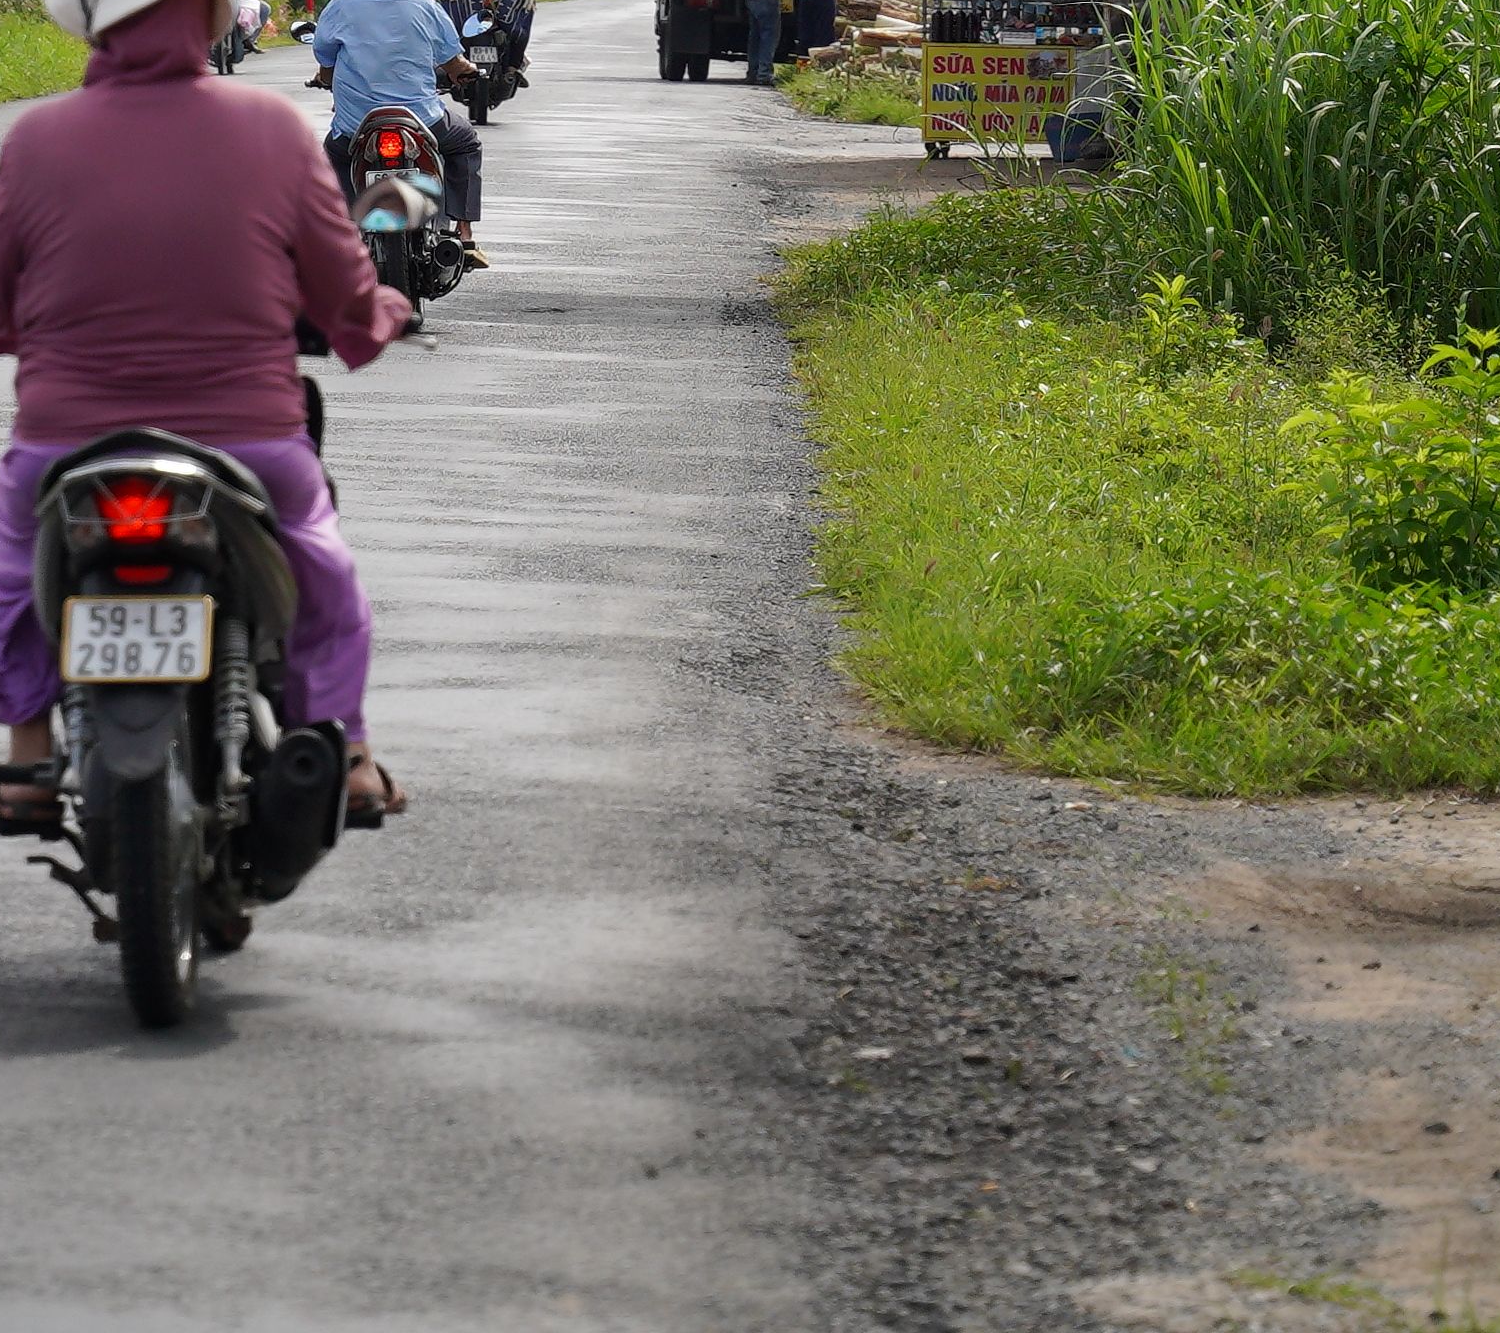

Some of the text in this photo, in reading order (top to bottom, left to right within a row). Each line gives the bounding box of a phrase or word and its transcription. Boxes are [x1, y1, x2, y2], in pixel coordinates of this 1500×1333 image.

[932, 52, 1025, 75] SỮA SEN
[985, 79, 1020, 102] MÍA
[88, 604, 188, 638] 59-L3
[76, 641, 196, 676] 298.76
